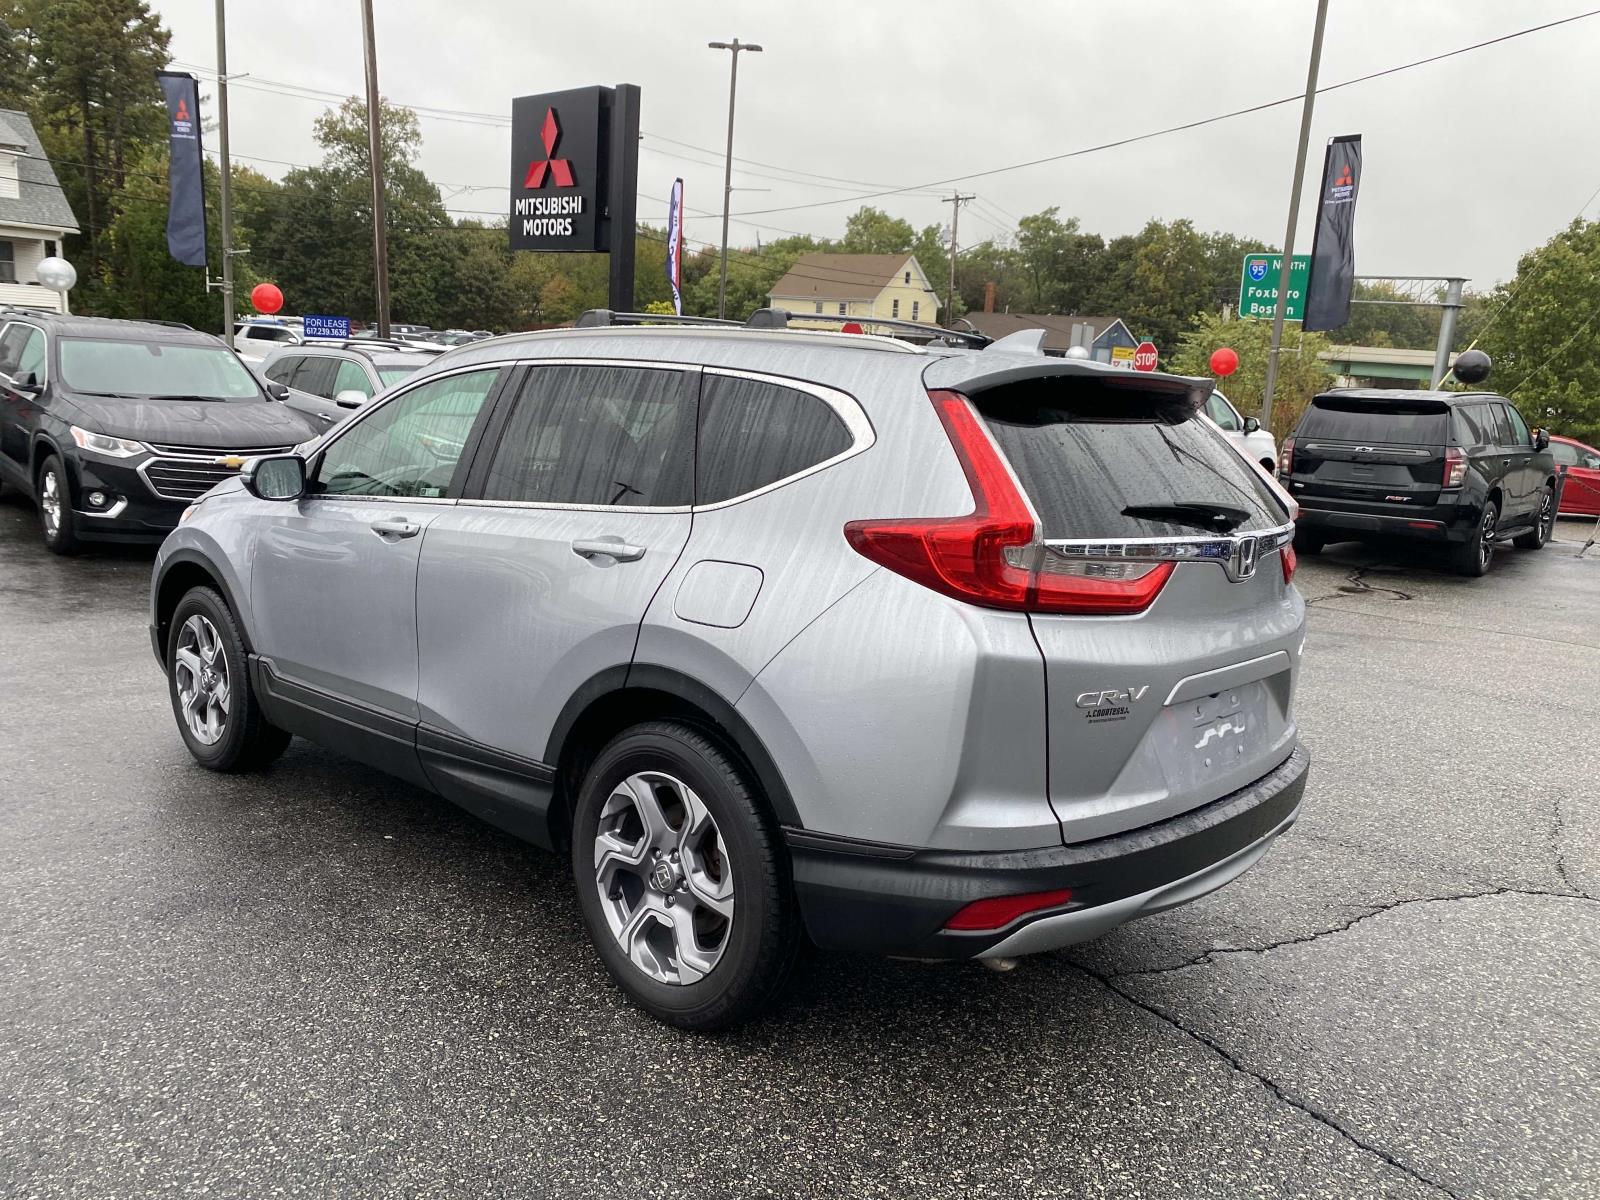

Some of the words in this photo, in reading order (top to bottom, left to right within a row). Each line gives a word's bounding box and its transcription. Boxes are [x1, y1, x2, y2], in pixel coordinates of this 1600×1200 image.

[515, 196, 582, 215] MITSUBISHI
[523, 218, 572, 236] MOTORS
[1252, 265, 1265, 276] 95
[1272, 259, 1306, 270] NRTH
[1248, 286, 1300, 299] Foxbro
[1250, 302, 1294, 315] Bostn
[305, 317, 322, 327] FOR
[323, 319, 348, 329] LEASE
[306, 327, 347, 337] 617.239.3636
[1135, 353, 1156, 366] STOP
[1076, 685, 1150, 708] CR-V
[1092, 706, 1125, 717] COURTESY
